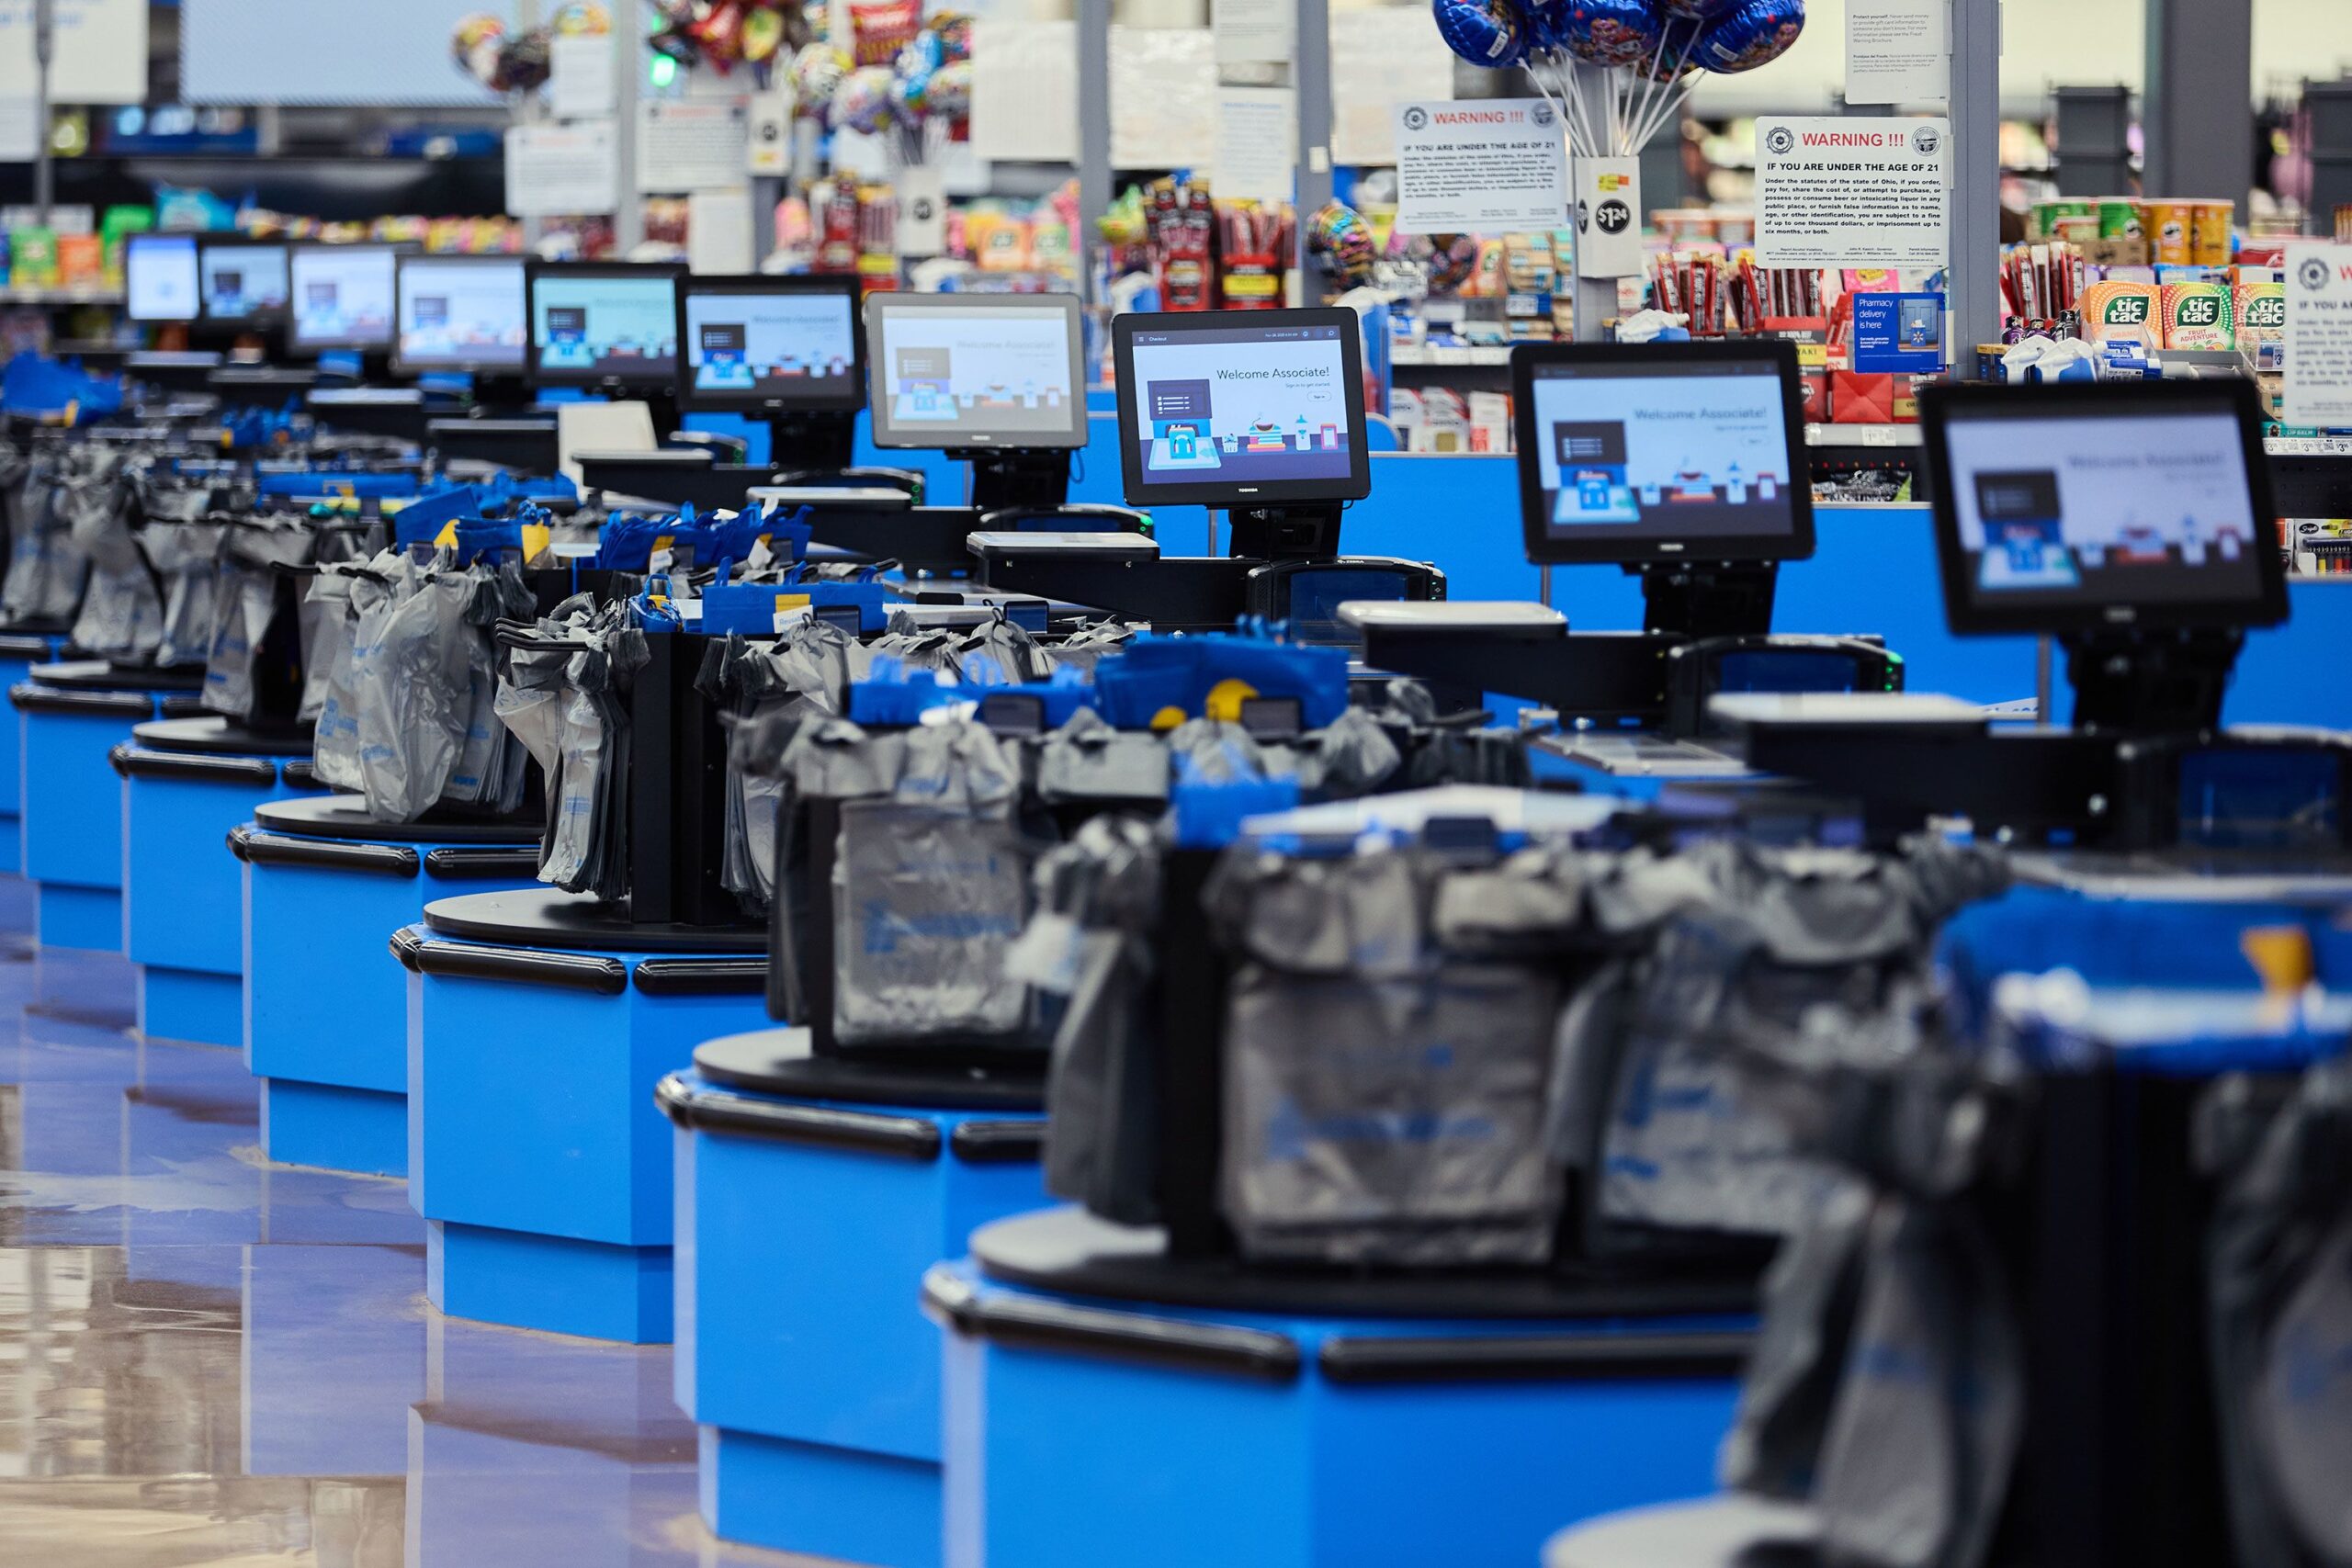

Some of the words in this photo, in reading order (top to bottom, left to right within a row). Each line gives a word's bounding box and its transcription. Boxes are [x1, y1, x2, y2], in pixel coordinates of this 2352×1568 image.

[1434, 111, 1505, 124] WARNING
[1510, 111, 1523, 122] !!!
[1802, 133, 1882, 146] WARNING
[1889, 133, 1903, 146] !!!
[1859, 299, 1893, 308] Pharmacy
[2116, 298, 2142, 312] tic
[2189, 298, 2213, 311] tic
[2259, 299, 2284, 313] tic
[1859, 310, 1886, 318] delivery
[2109, 311, 2142, 323] tac
[2182, 310, 2212, 323] tac
[2180, 333, 2218, 342] ADVENTURE
[1217, 368, 1269, 380] Welcome
[1272, 366, 1330, 378] Associate!
